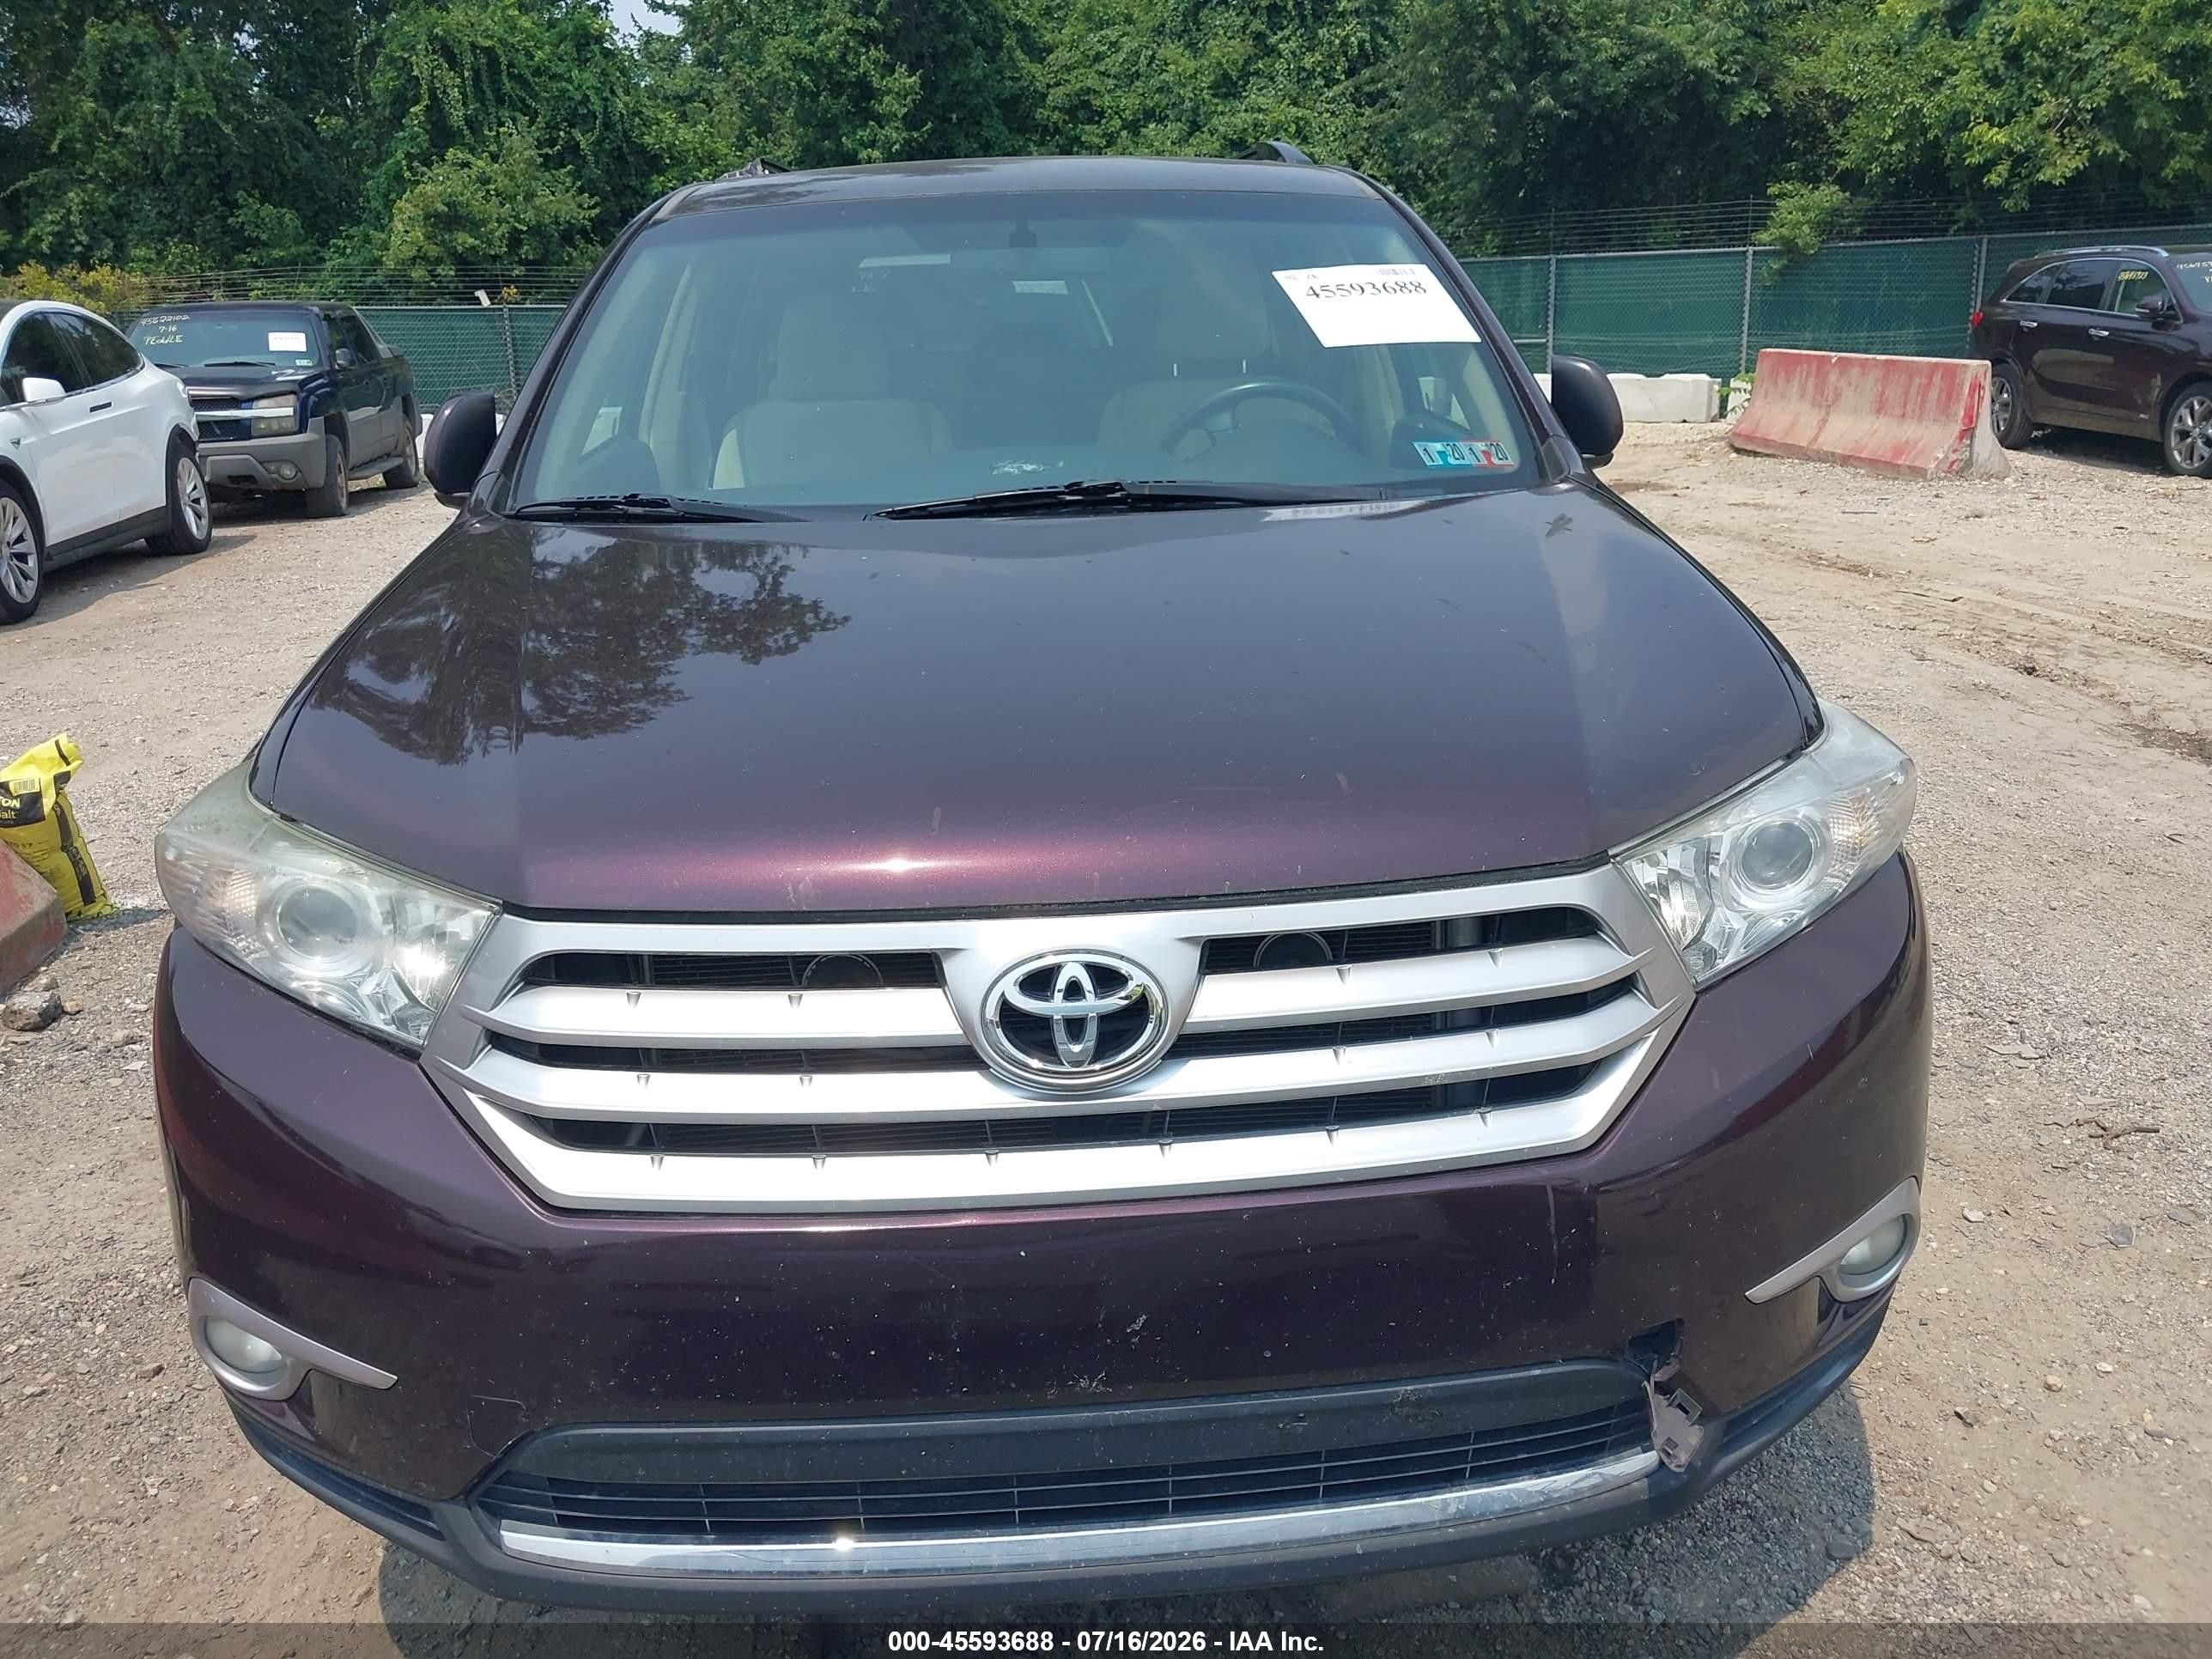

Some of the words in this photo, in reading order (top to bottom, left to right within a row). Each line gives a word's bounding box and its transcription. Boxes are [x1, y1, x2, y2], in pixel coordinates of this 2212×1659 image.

[1305, 281, 1427, 299] 45593688
[1445, 443, 1466, 460] 20
[1489, 442, 1510, 460] 20
[0, 810, 17, 819] alt
